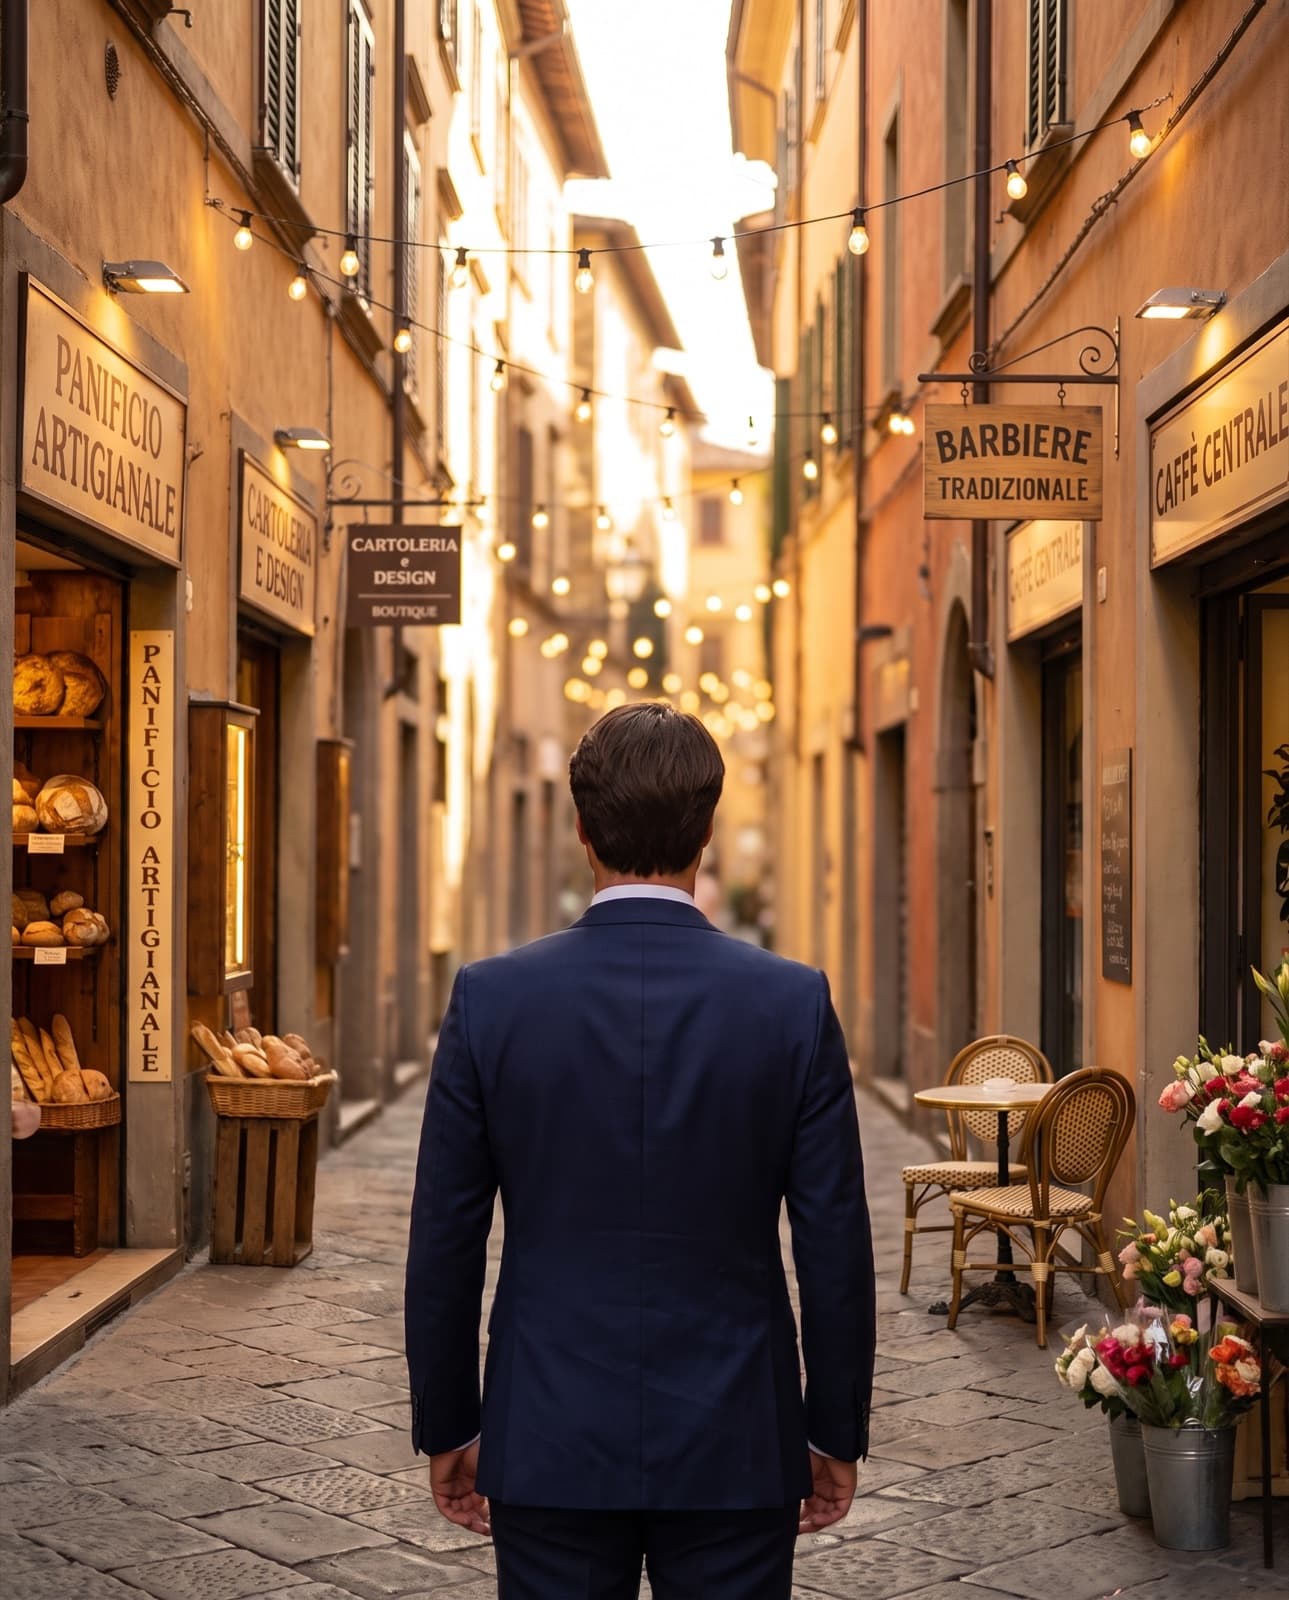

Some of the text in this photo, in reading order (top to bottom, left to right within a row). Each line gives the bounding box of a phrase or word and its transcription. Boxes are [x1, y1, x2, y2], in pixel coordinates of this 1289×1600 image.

[55, 334, 163, 460] PANIFICIO
[935, 423, 1092, 465] BARBIERE
[1155, 379, 1289, 517] CAFFÈ CENTRALE
[32, 406, 176, 538] ARTIGIANALE
[938, 477, 1088, 501] TRADIZIONALE
[247, 483, 312, 568] CARTOLERIA
[351, 537, 458, 553] CARTOLERIA
[255, 544, 305, 610] E DESIGN
[373, 570, 437, 585] DESIGN
[400, 557, 410, 568] e
[371, 605, 438, 620] BOUTIQUE
[140, 644, 162, 1073] PANIFICIO ARTIGIANALE
